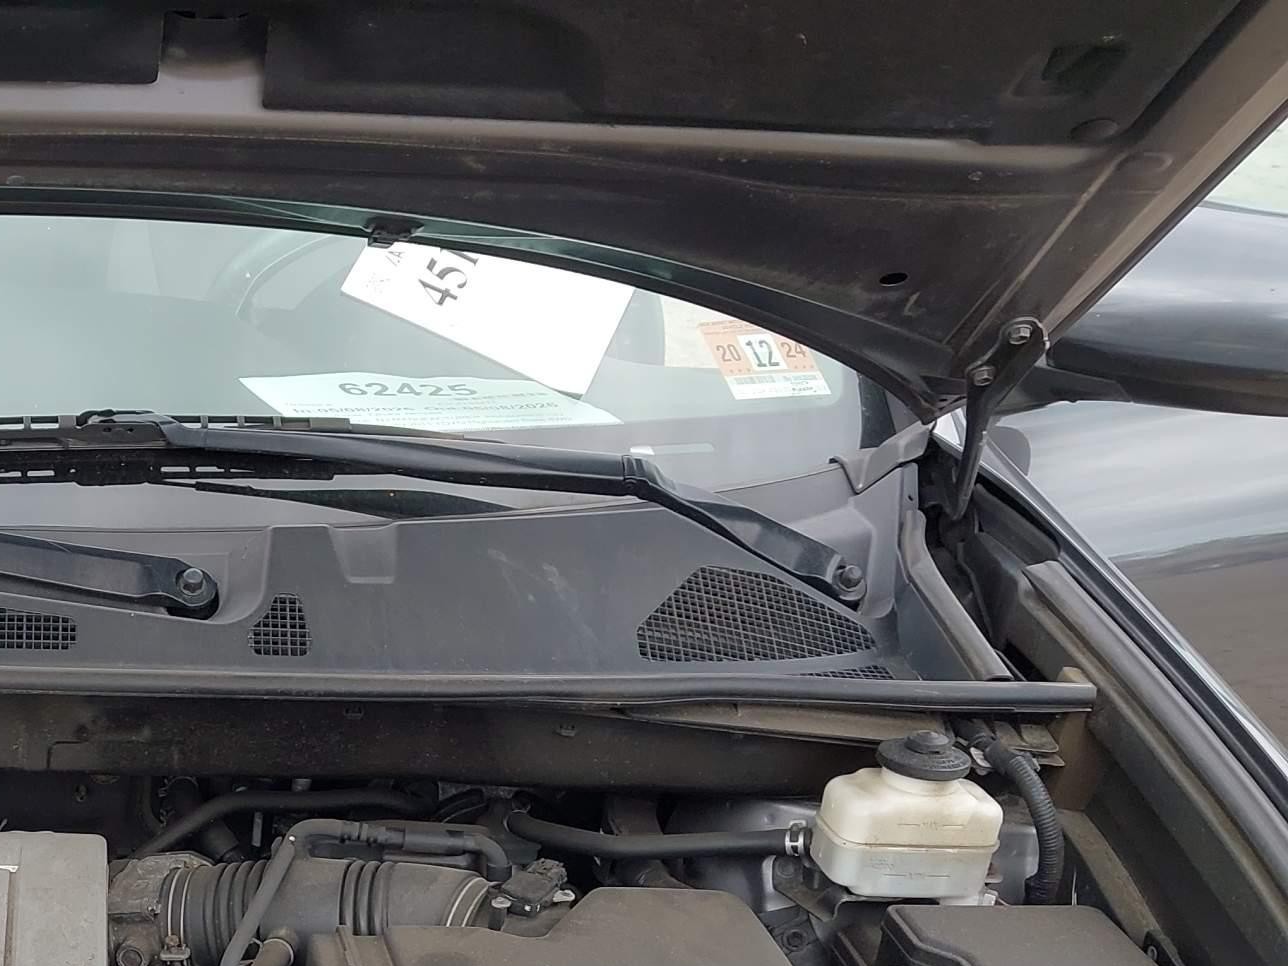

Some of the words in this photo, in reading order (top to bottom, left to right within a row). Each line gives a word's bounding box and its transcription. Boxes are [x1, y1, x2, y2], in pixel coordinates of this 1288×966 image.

[716, 343, 742, 363] 20
[745, 340, 780, 368] 12
[781, 342, 807, 358] 24
[338, 382, 478, 397] 62425
